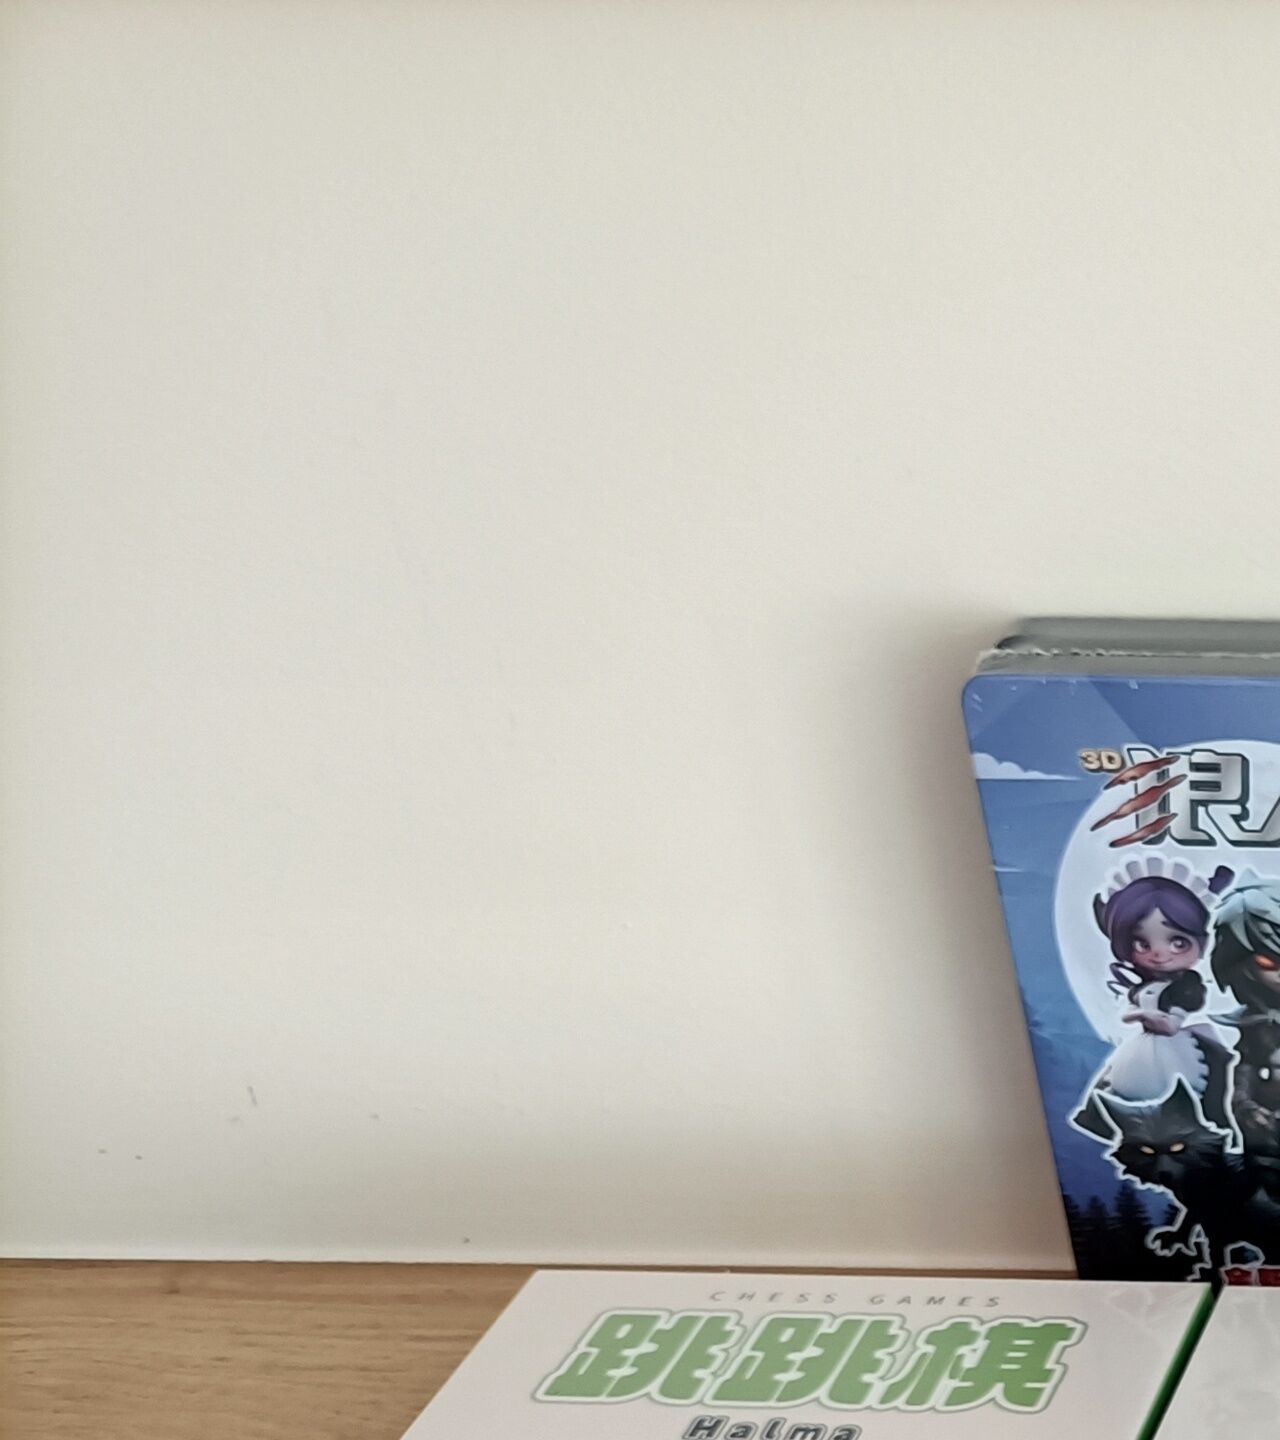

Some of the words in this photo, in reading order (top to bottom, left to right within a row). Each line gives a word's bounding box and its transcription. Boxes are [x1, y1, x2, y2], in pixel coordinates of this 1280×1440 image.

[1079, 748, 1123, 771] 3D
[708, 1292, 840, 1304] CHESS
[867, 1295, 1002, 1308] GAMES
[532, 1308, 1088, 1415] 跳跳棋
